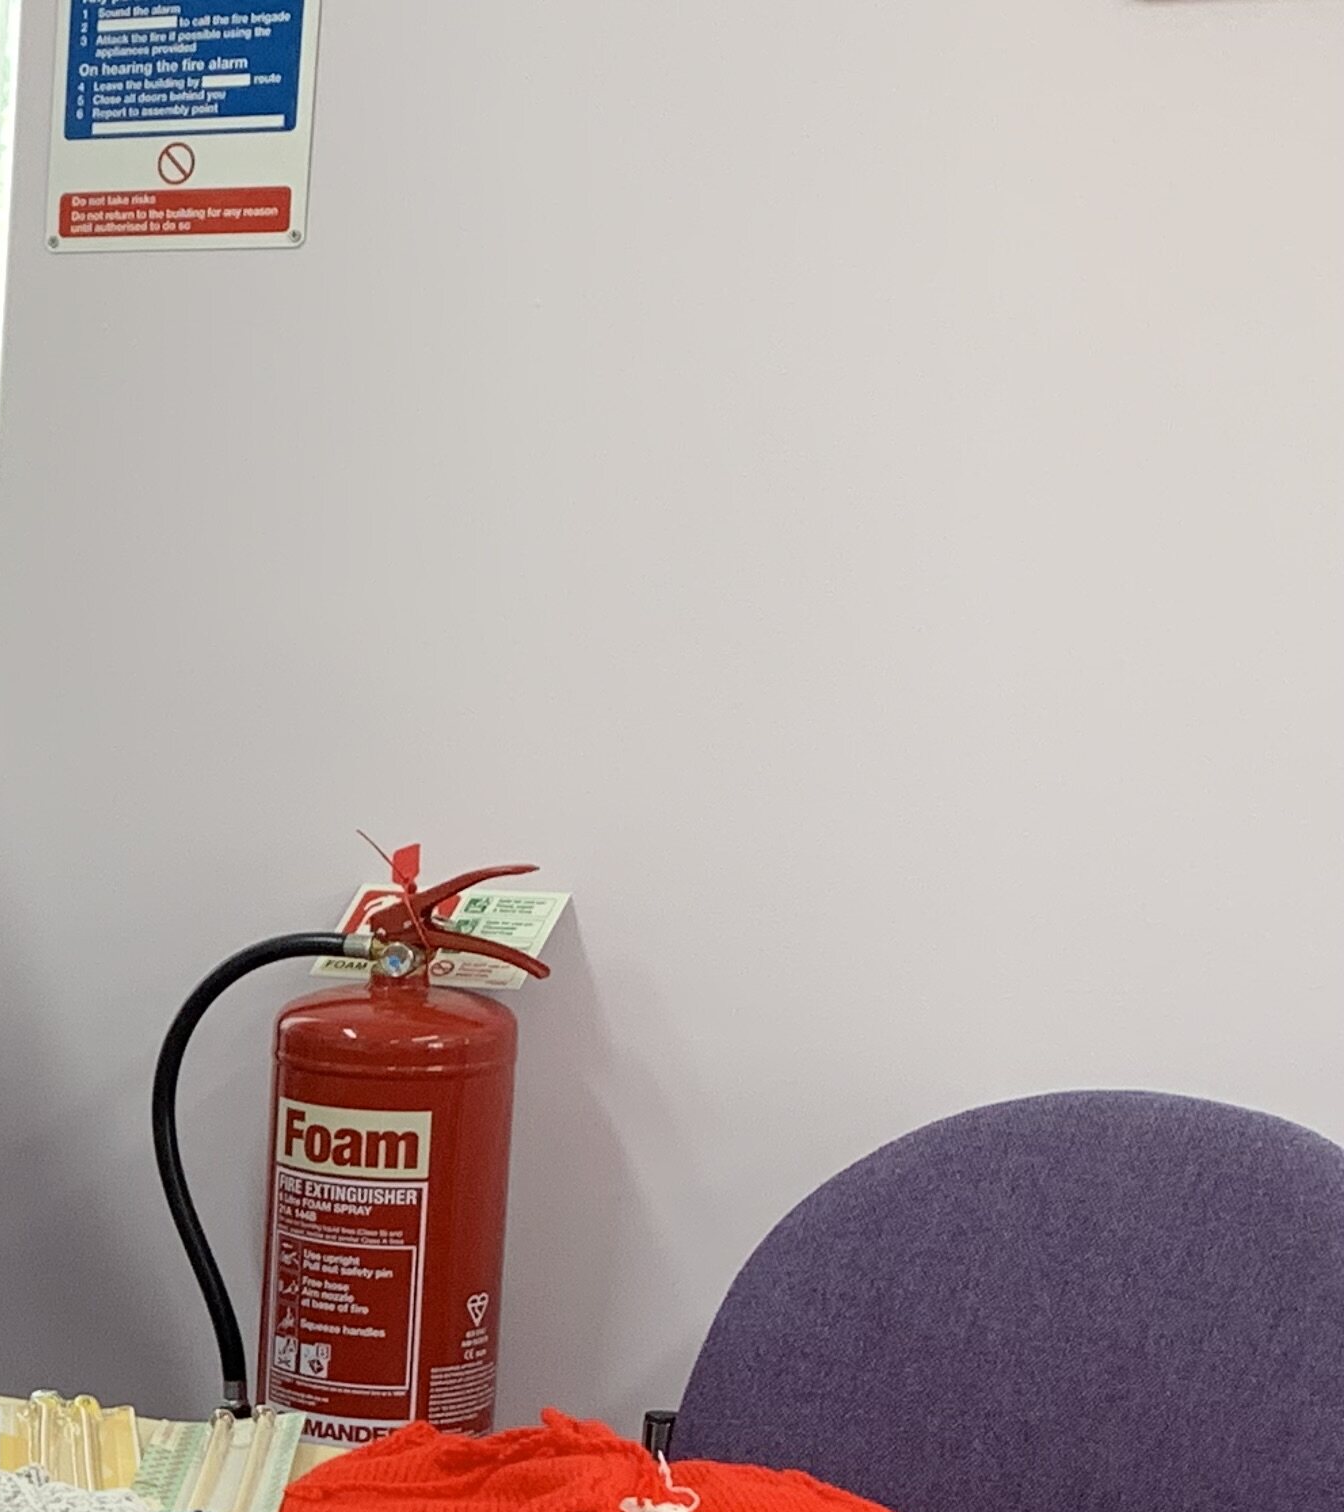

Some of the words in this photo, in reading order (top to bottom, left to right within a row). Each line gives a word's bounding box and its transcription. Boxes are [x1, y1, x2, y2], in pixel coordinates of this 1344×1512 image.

[82, 9, 88, 19] 1
[97, 7, 131, 18] Sound
[133, 6, 149, 15] the
[152, 4, 181, 14] alarm
[80, 22, 88, 33] 2
[179, 17, 190, 27] to
[192, 15, 211, 26] call
[212, 15, 229, 25] the
[231, 13, 249, 24] fire
[250, 11, 291, 25] brigade
[80, 35, 88, 47] 3
[96, 34, 129, 45] Attack
[131, 33, 148, 43] the
[150, 31, 167, 42] fire
[168, 31, 176, 41] if
[178, 29, 221, 42] possible
[223, 27, 252, 40] using
[254, 26, 272, 37] the
[95, 46, 150, 58] appliances
[152, 42, 197, 56] provided
[79, 63, 99, 77] On
[101, 61, 153, 76] hearing
[156, 59, 179, 73] the
[182, 57, 205, 71] fire
[208, 56, 248, 71] alarm
[77, 82, 85, 92] 4
[93, 81, 124, 92] Leave
[125, 80, 142, 90] the
[144, 78, 186, 90] building
[187, 76, 200, 89] by
[253, 73, 282, 84] route
[77, 95, 85, 106] 5
[93, 95, 122, 105] Close
[123, 93, 136, 103] all
[138, 92, 168, 103] doors
[169, 90, 205, 101] behind
[207, 90, 226, 102] you
[76, 108, 84, 119] 6
[92, 107, 127, 119] Report
[128, 107, 140, 117] to
[141, 104, 190, 117] assembly
[192, 103, 218, 116] point
[72, 196, 87, 207] Do
[88, 195, 106, 206] not
[107, 194, 130, 206] take
[131, 193, 156, 204] risks
[72, 211, 86, 222] Do
[87, 210, 104, 221] not
[105, 209, 135, 220] return
[136, 209, 147, 219] to
[148, 208, 164, 219] the
[166, 207, 206, 220] building
[207, 206, 222, 217] for
[223, 208, 242, 219] any
[243, 206, 279, 216] reason
[71, 223, 93, 233] until
[94, 220, 148, 233] authorised
[150, 220, 161, 231] to
[162, 220, 176, 231] do
[178, 221, 191, 231] so
[323, 959, 368, 970] FOAM
[285, 1107, 419, 1169] Foam
[279, 1174, 302, 1195] FIRE
[305, 1181, 418, 1205] EXTINGUISHER
[302, 1197, 332, 1212] FOAM
[333, 1203, 373, 1217] SPRAY
[303, 1248, 321, 1260] Use
[322, 1254, 360, 1267] upright
[302, 1260, 321, 1271] Pull
[321, 1264, 339, 1275] out
[340, 1266, 373, 1280] safety
[375, 1267, 393, 1280] pin
[302, 1275, 323, 1288] Free
[324, 1280, 350, 1292] hose
[301, 1286, 320, 1297] Aim
[321, 1291, 355, 1303] nozzle
[301, 1298, 310, 1308] at
[311, 1299, 336, 1312] base
[337, 1303, 349, 1314] of
[350, 1303, 369, 1315] fire
[299, 1317, 341, 1334] Squeeze
[342, 1325, 386, 1338] handles
[302, 1418, 402, 1443] MANDE
